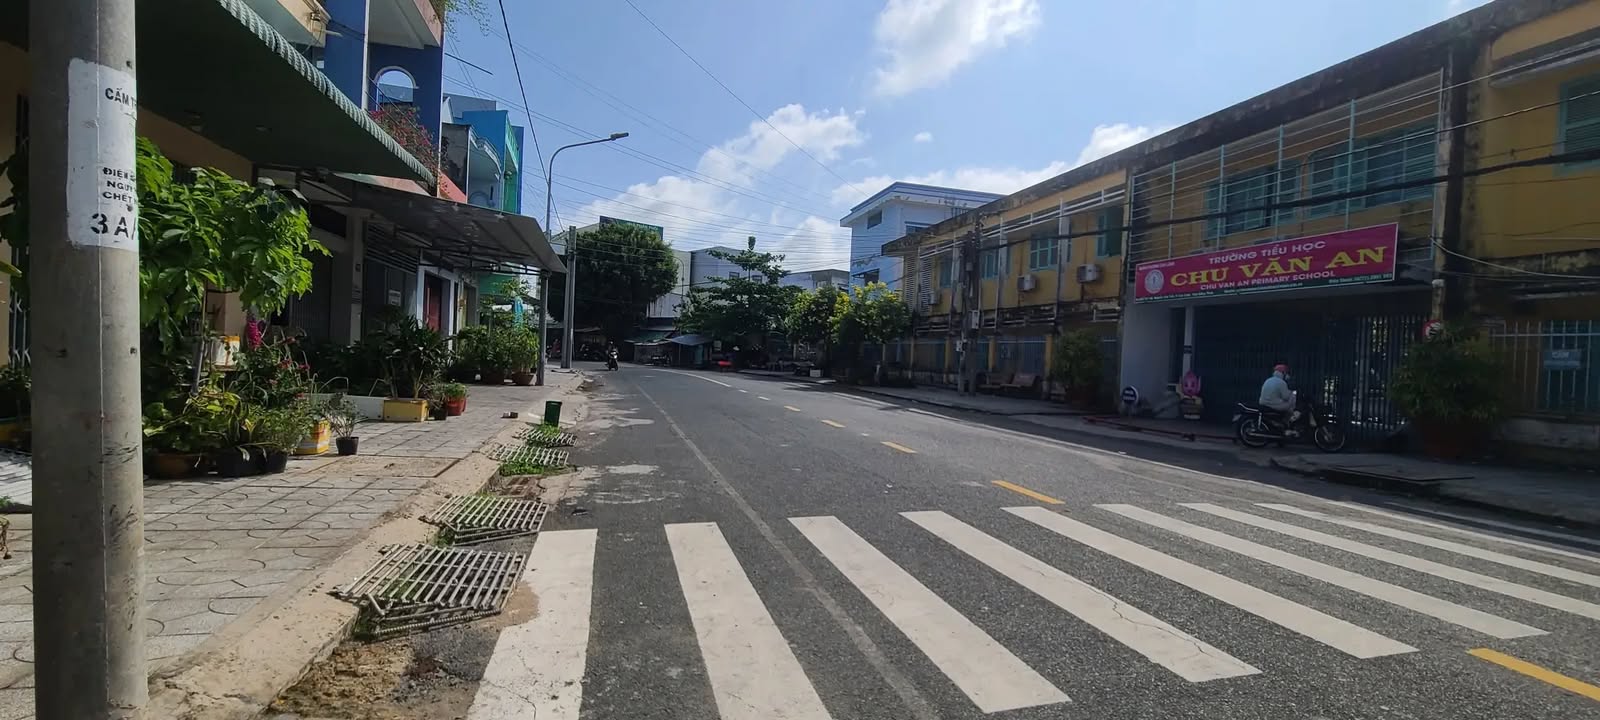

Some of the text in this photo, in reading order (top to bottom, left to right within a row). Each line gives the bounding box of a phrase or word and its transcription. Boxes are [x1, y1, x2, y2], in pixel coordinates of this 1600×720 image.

[105, 87, 129, 105] CẤM
[1209, 240, 1326, 264] TRƯỜNG TIỂU HỌC
[1170, 246, 1388, 287] CHU VĂN AN
[1200, 283, 1218, 291] CHU
[1219, 281, 1236, 290] VAN
[1237, 279, 1251, 287] AN
[1251, 275, 1290, 286] PRIMARY
[1292, 270, 1336, 282] SCHOOL
